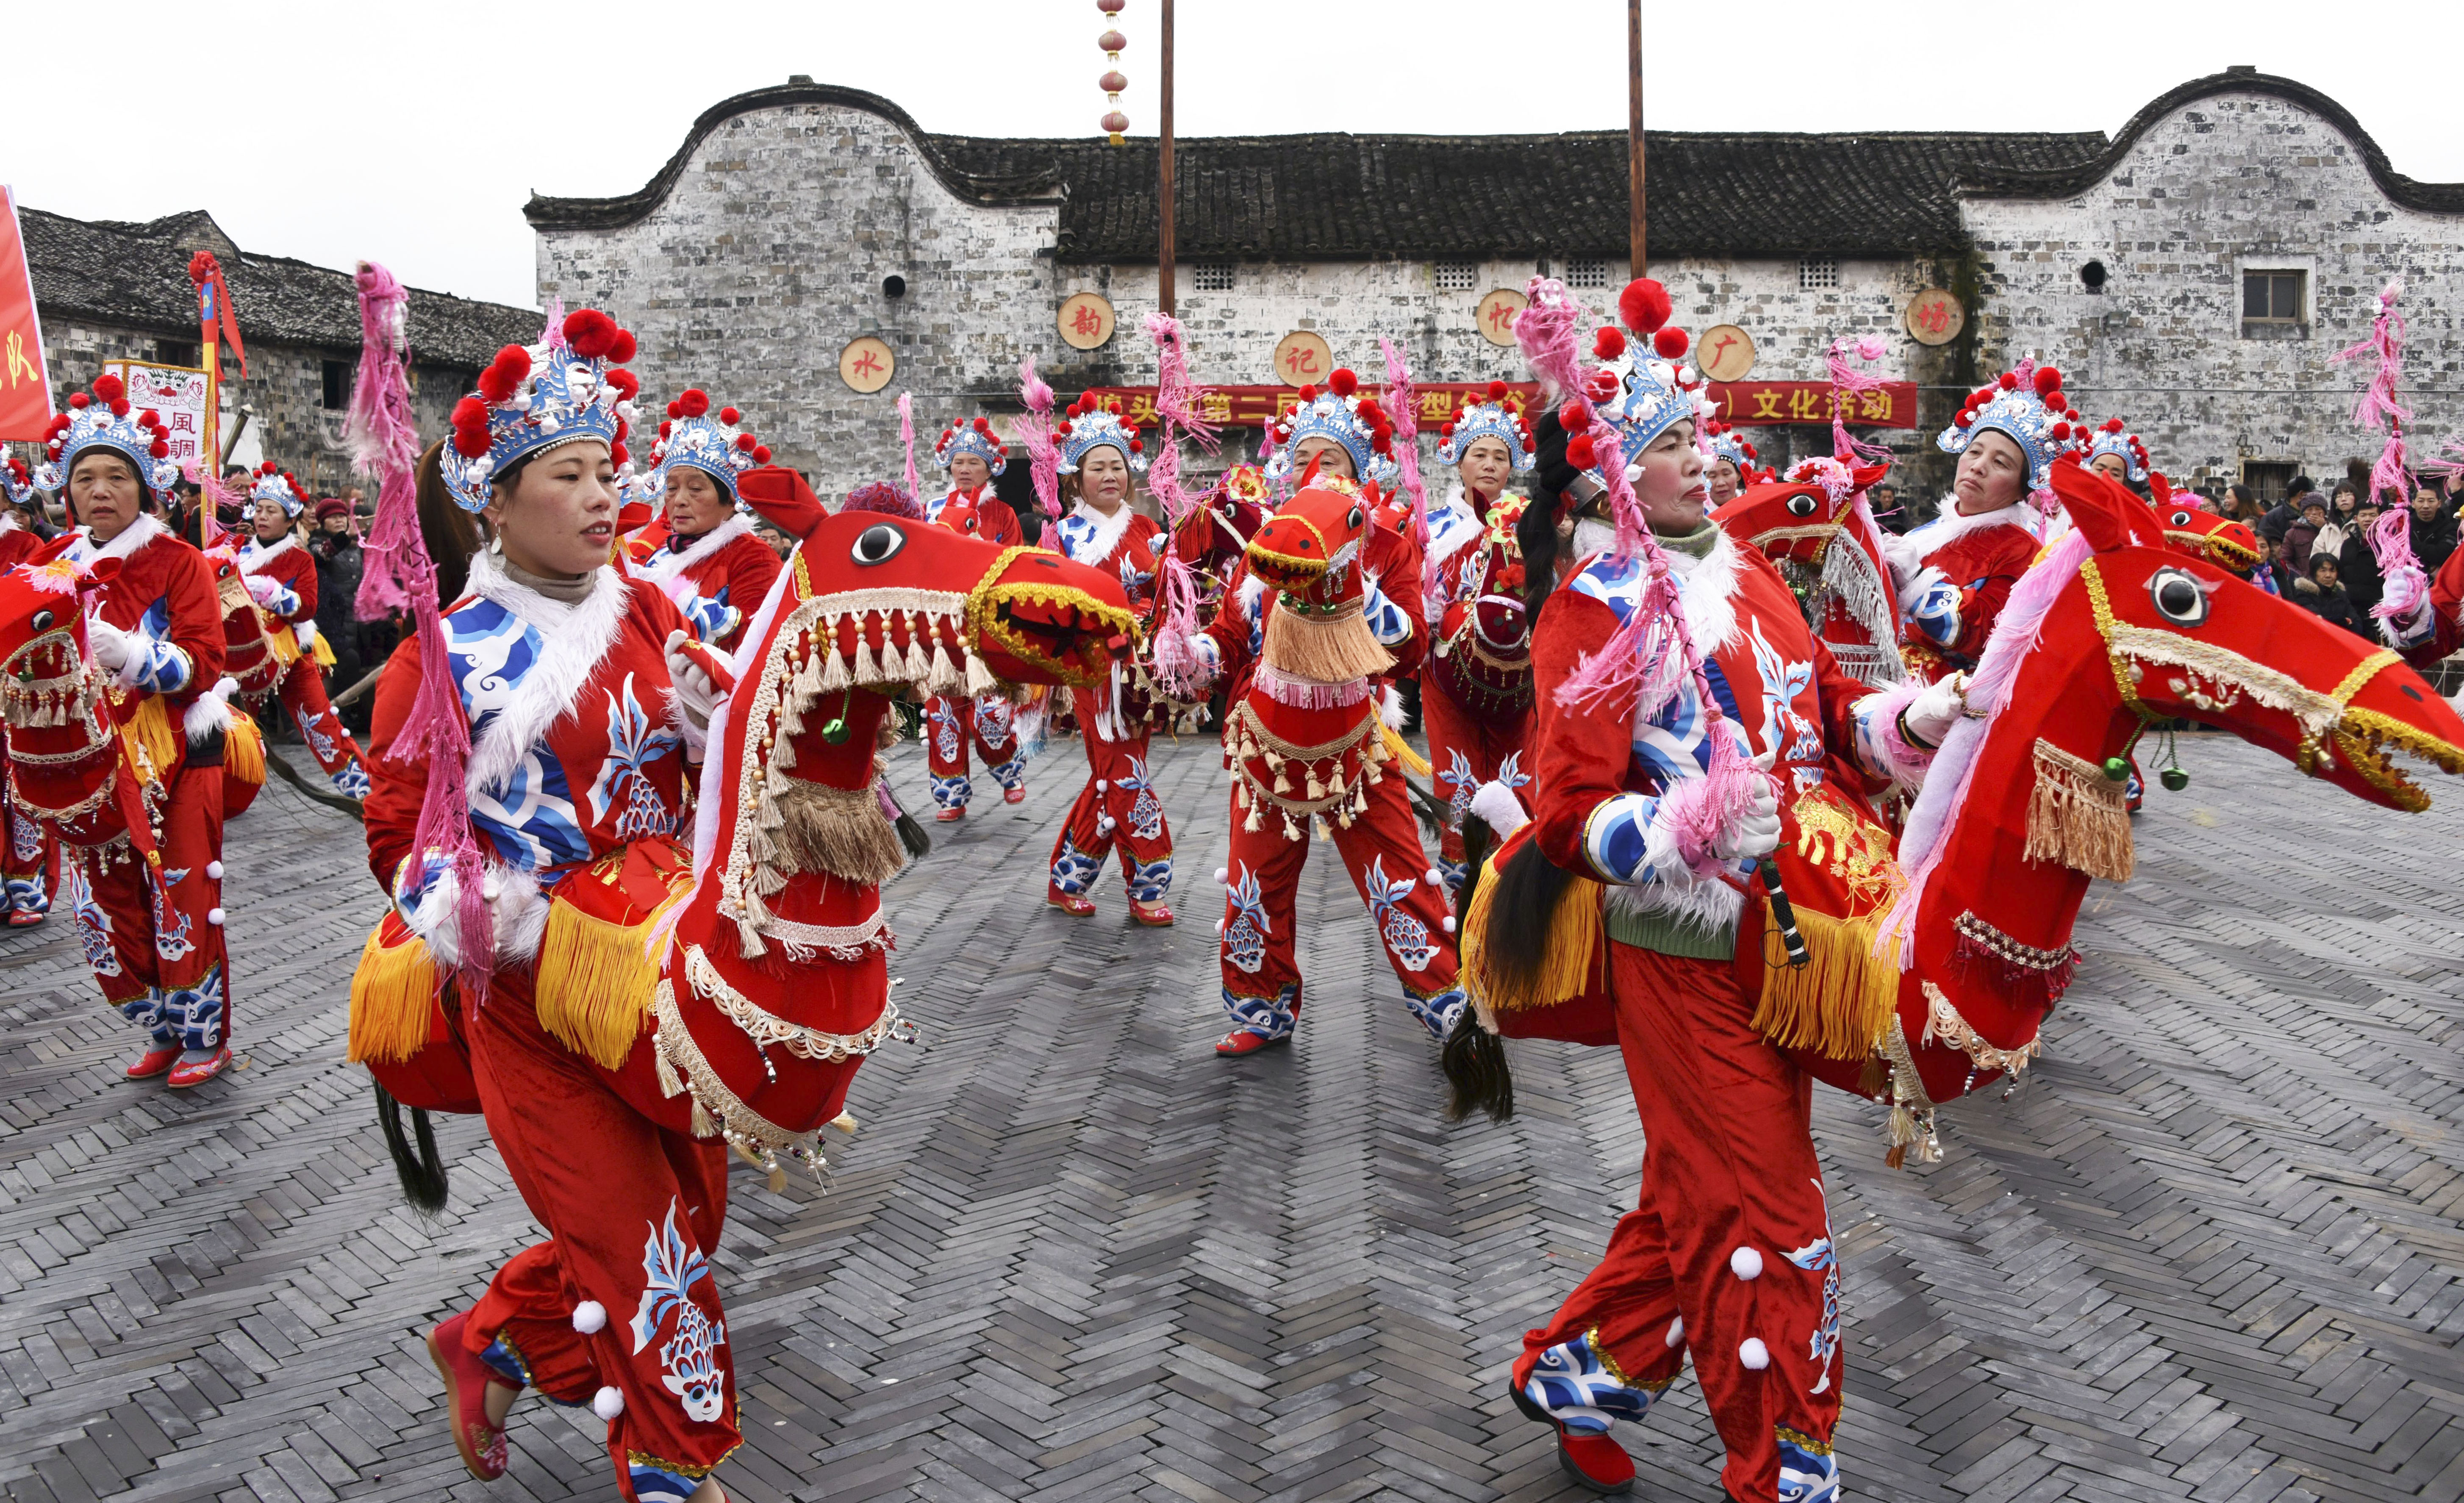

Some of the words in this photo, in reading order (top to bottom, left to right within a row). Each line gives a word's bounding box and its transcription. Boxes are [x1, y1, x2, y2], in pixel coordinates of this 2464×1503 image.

[1068, 305, 1102, 337] 韵
[1489, 302, 1515, 333] 忆
[1917, 300, 1949, 333] 场
[0, 329, 39, 390] 队
[852, 350, 884, 379] 水
[1286, 347, 1319, 374] 记
[1709, 334, 1738, 369] 广
[169, 411, 196, 460] 風調
